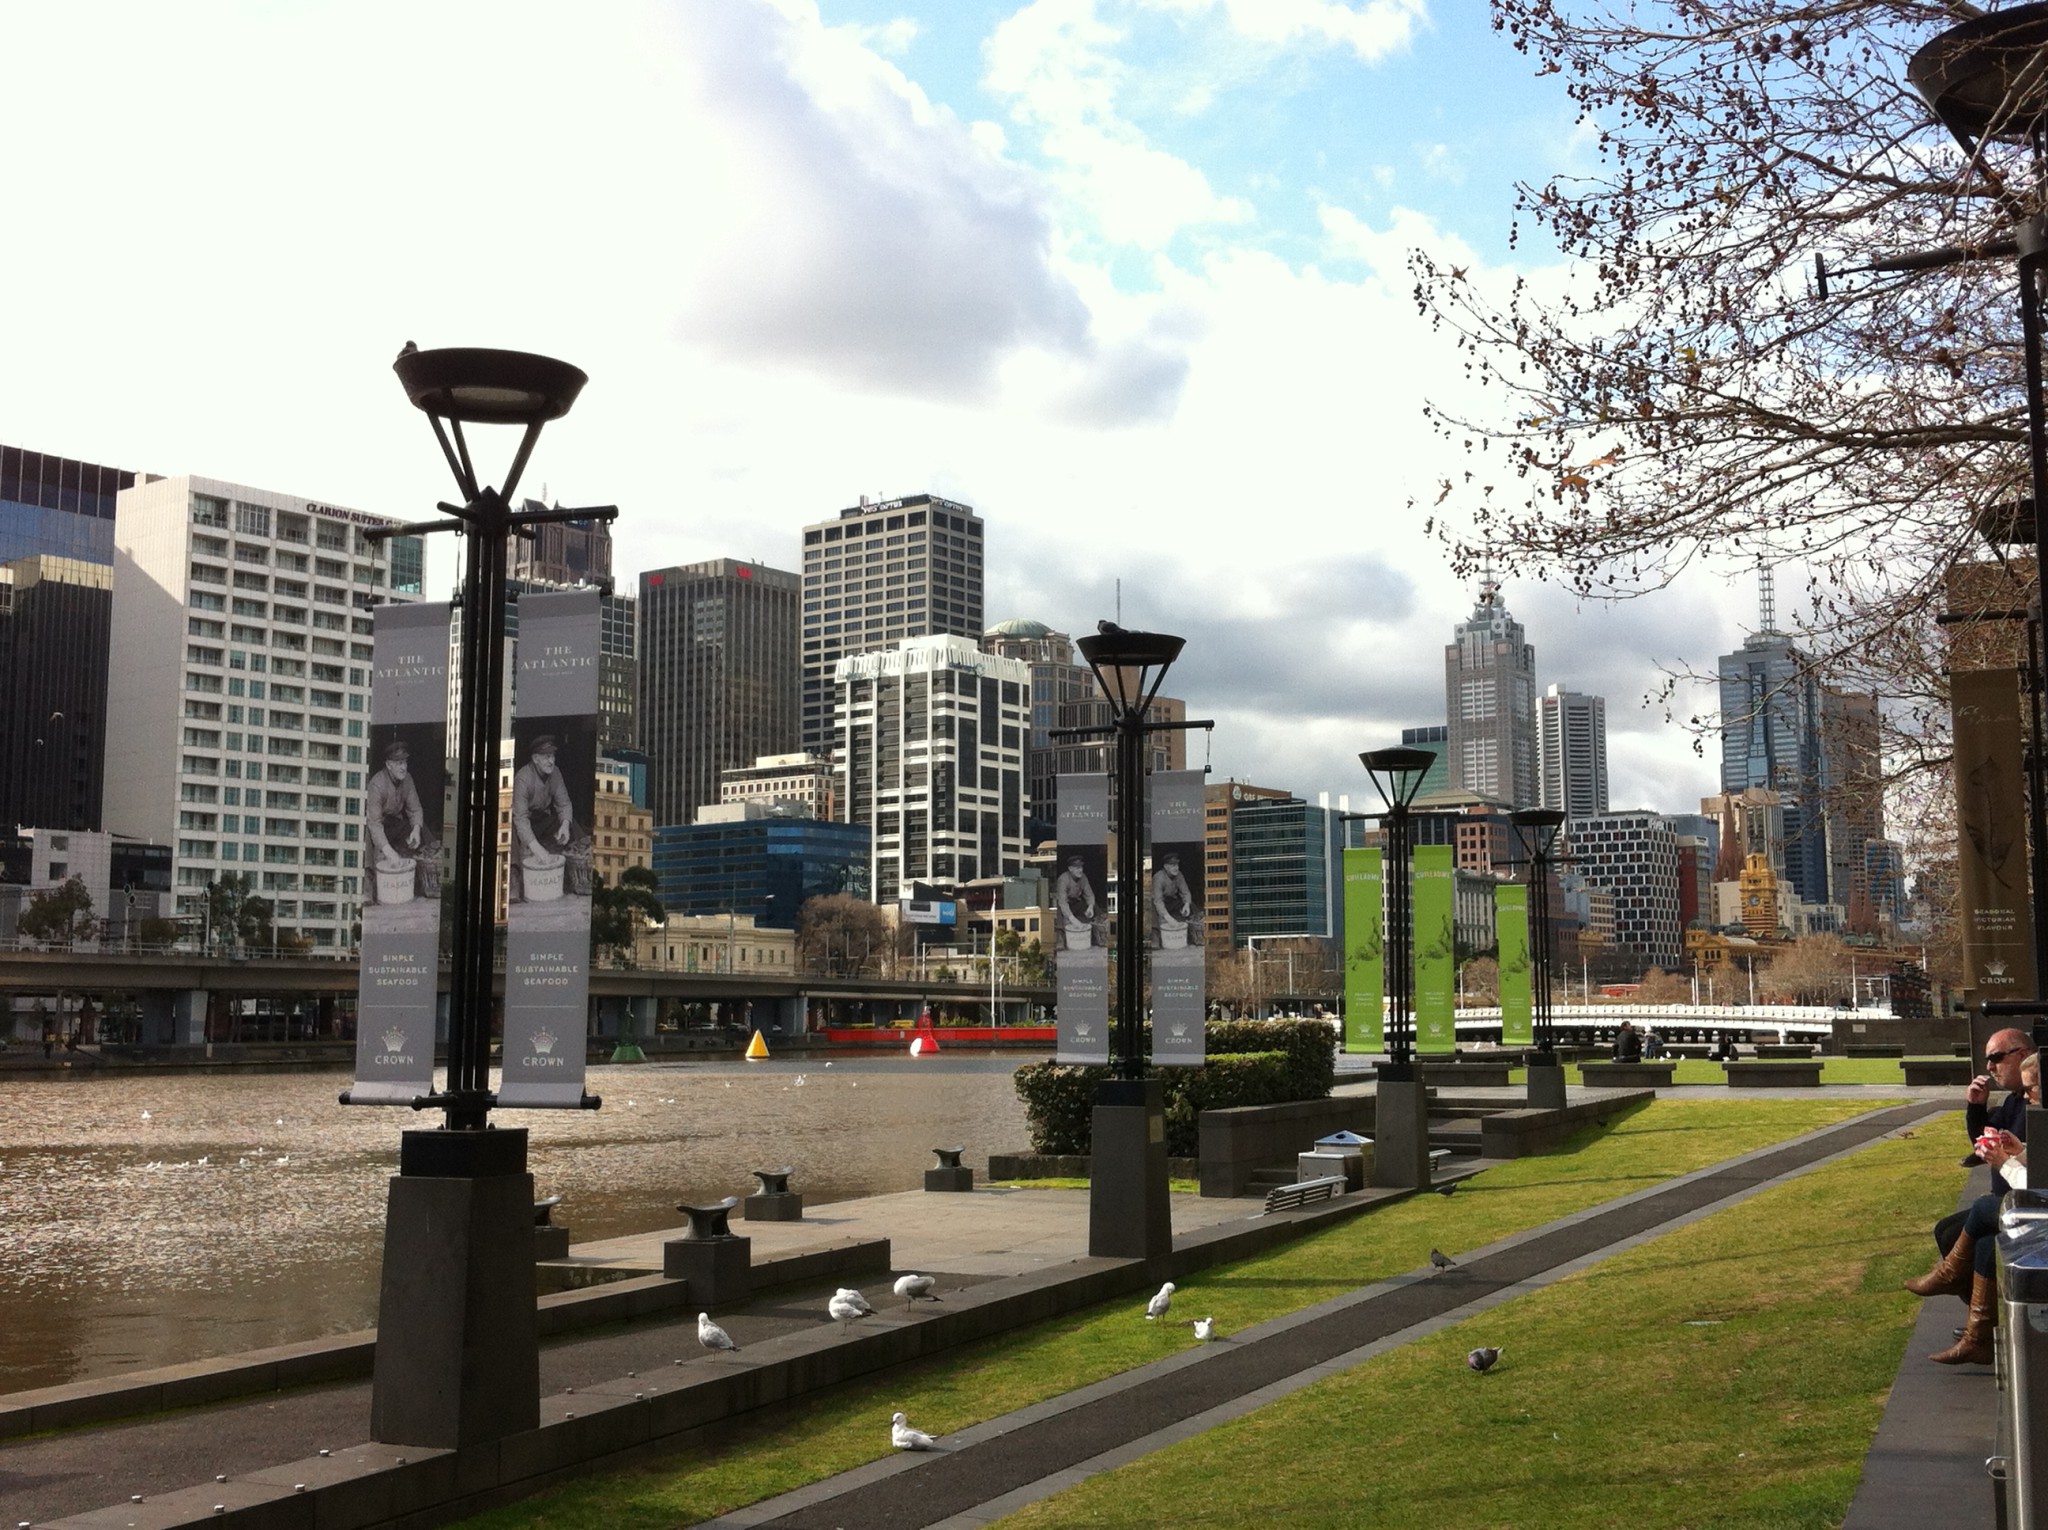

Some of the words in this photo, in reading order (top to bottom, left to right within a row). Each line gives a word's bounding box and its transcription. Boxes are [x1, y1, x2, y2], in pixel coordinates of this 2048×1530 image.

[306, 503, 350, 520] CLARION
[543, 646, 573, 656] THE
[398, 655, 425, 664] THE
[520, 656, 594, 671] ATLANTIC
[376, 666, 444, 678] ATLANTIC
[382, 954, 415, 962] SIMPLE
[530, 953, 564, 961] SIMPLE
[368, 966, 428, 974] SUSTAINABLE
[515, 965, 578, 973] SUSTAINABLE
[376, 978, 419, 986] SEAFOOD
[524, 977, 569, 985] SEAFOOD
[374, 1055, 415, 1065] CROWN
[522, 1056, 565, 1067] CROWN
